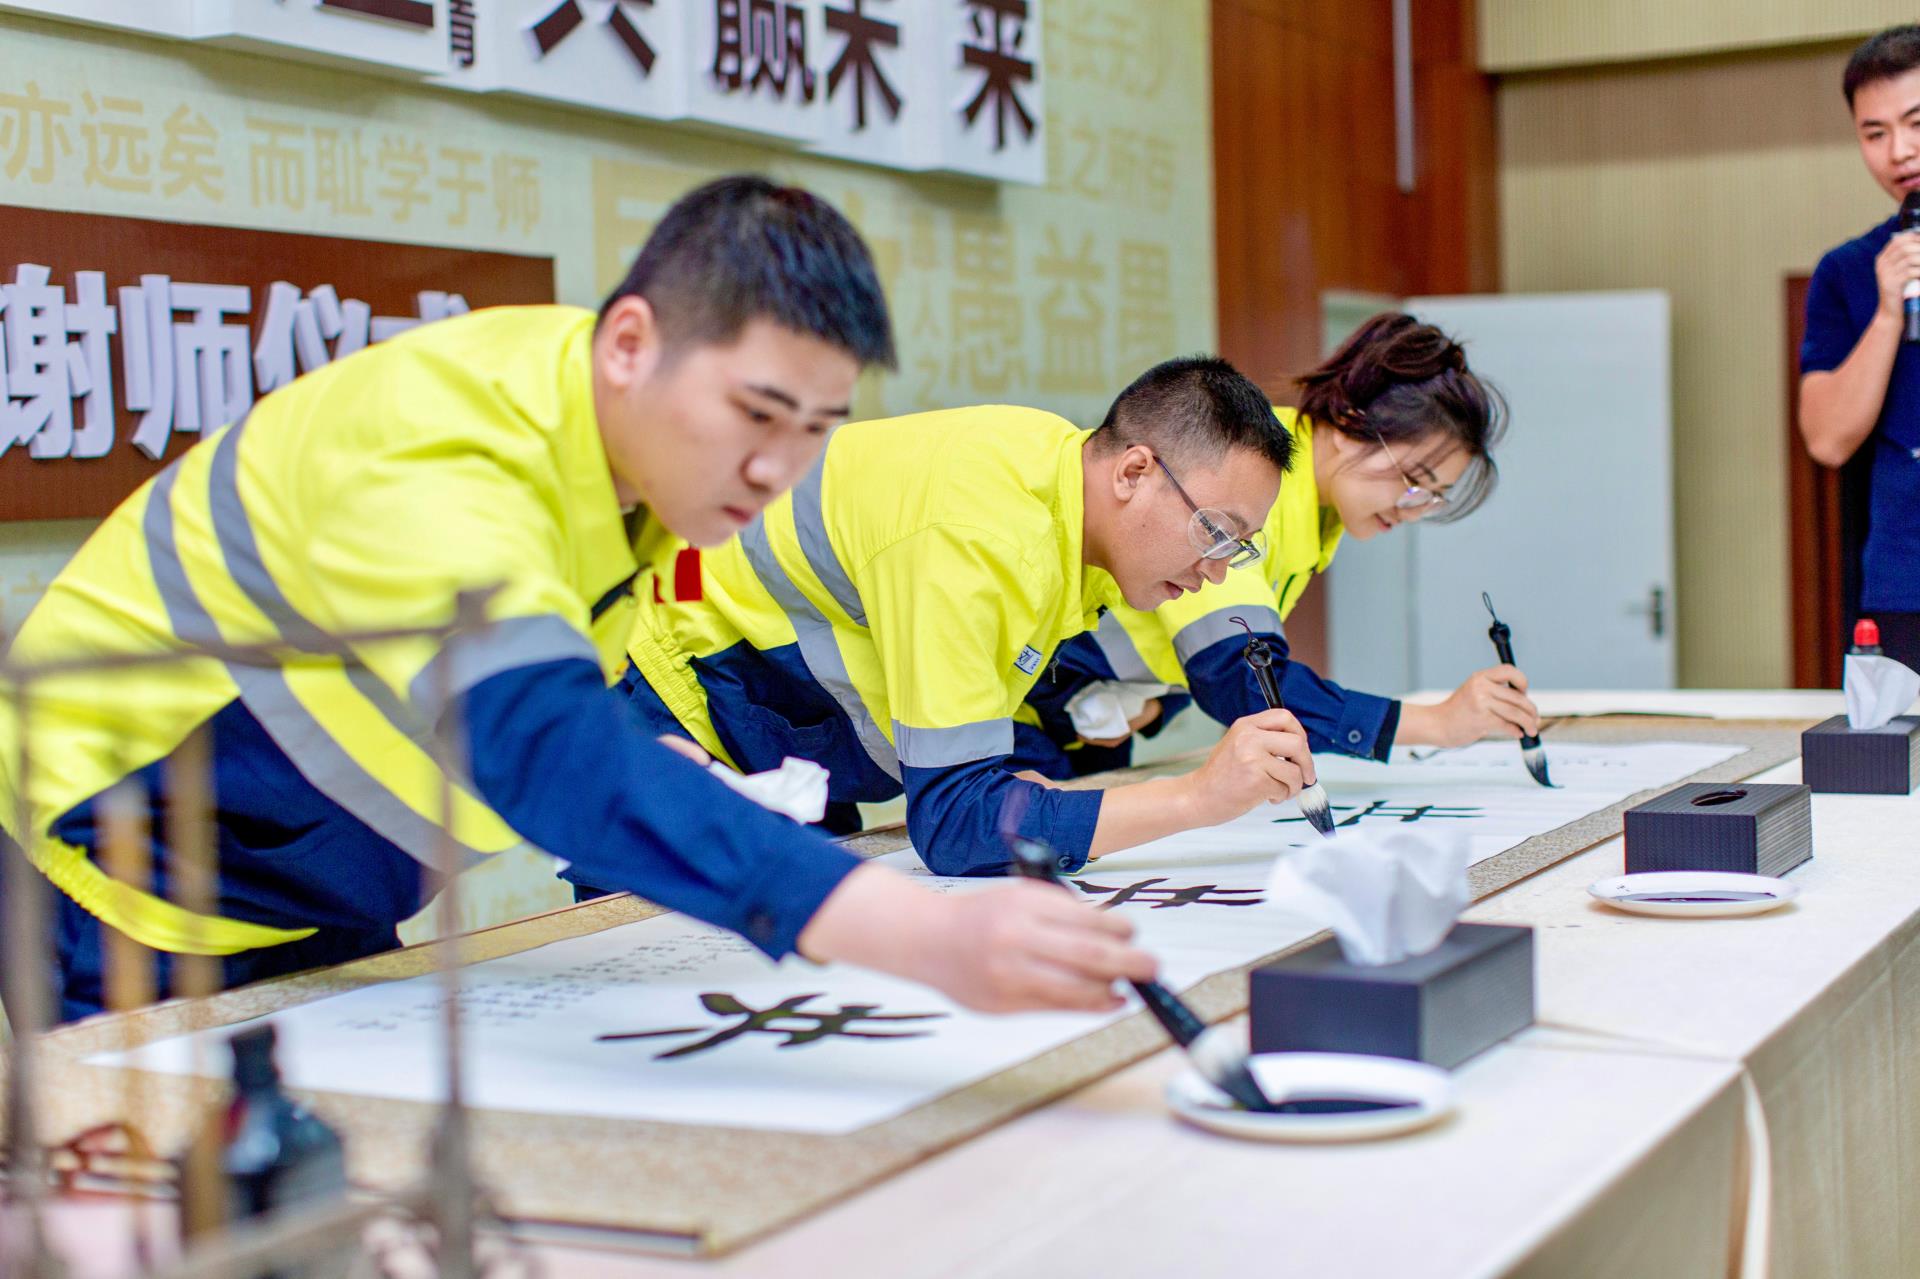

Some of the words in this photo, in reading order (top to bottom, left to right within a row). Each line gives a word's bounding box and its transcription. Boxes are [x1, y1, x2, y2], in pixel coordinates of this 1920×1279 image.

[0, 82, 225, 202] 亦远矣
[245, 116, 543, 236] 而耻学于师
